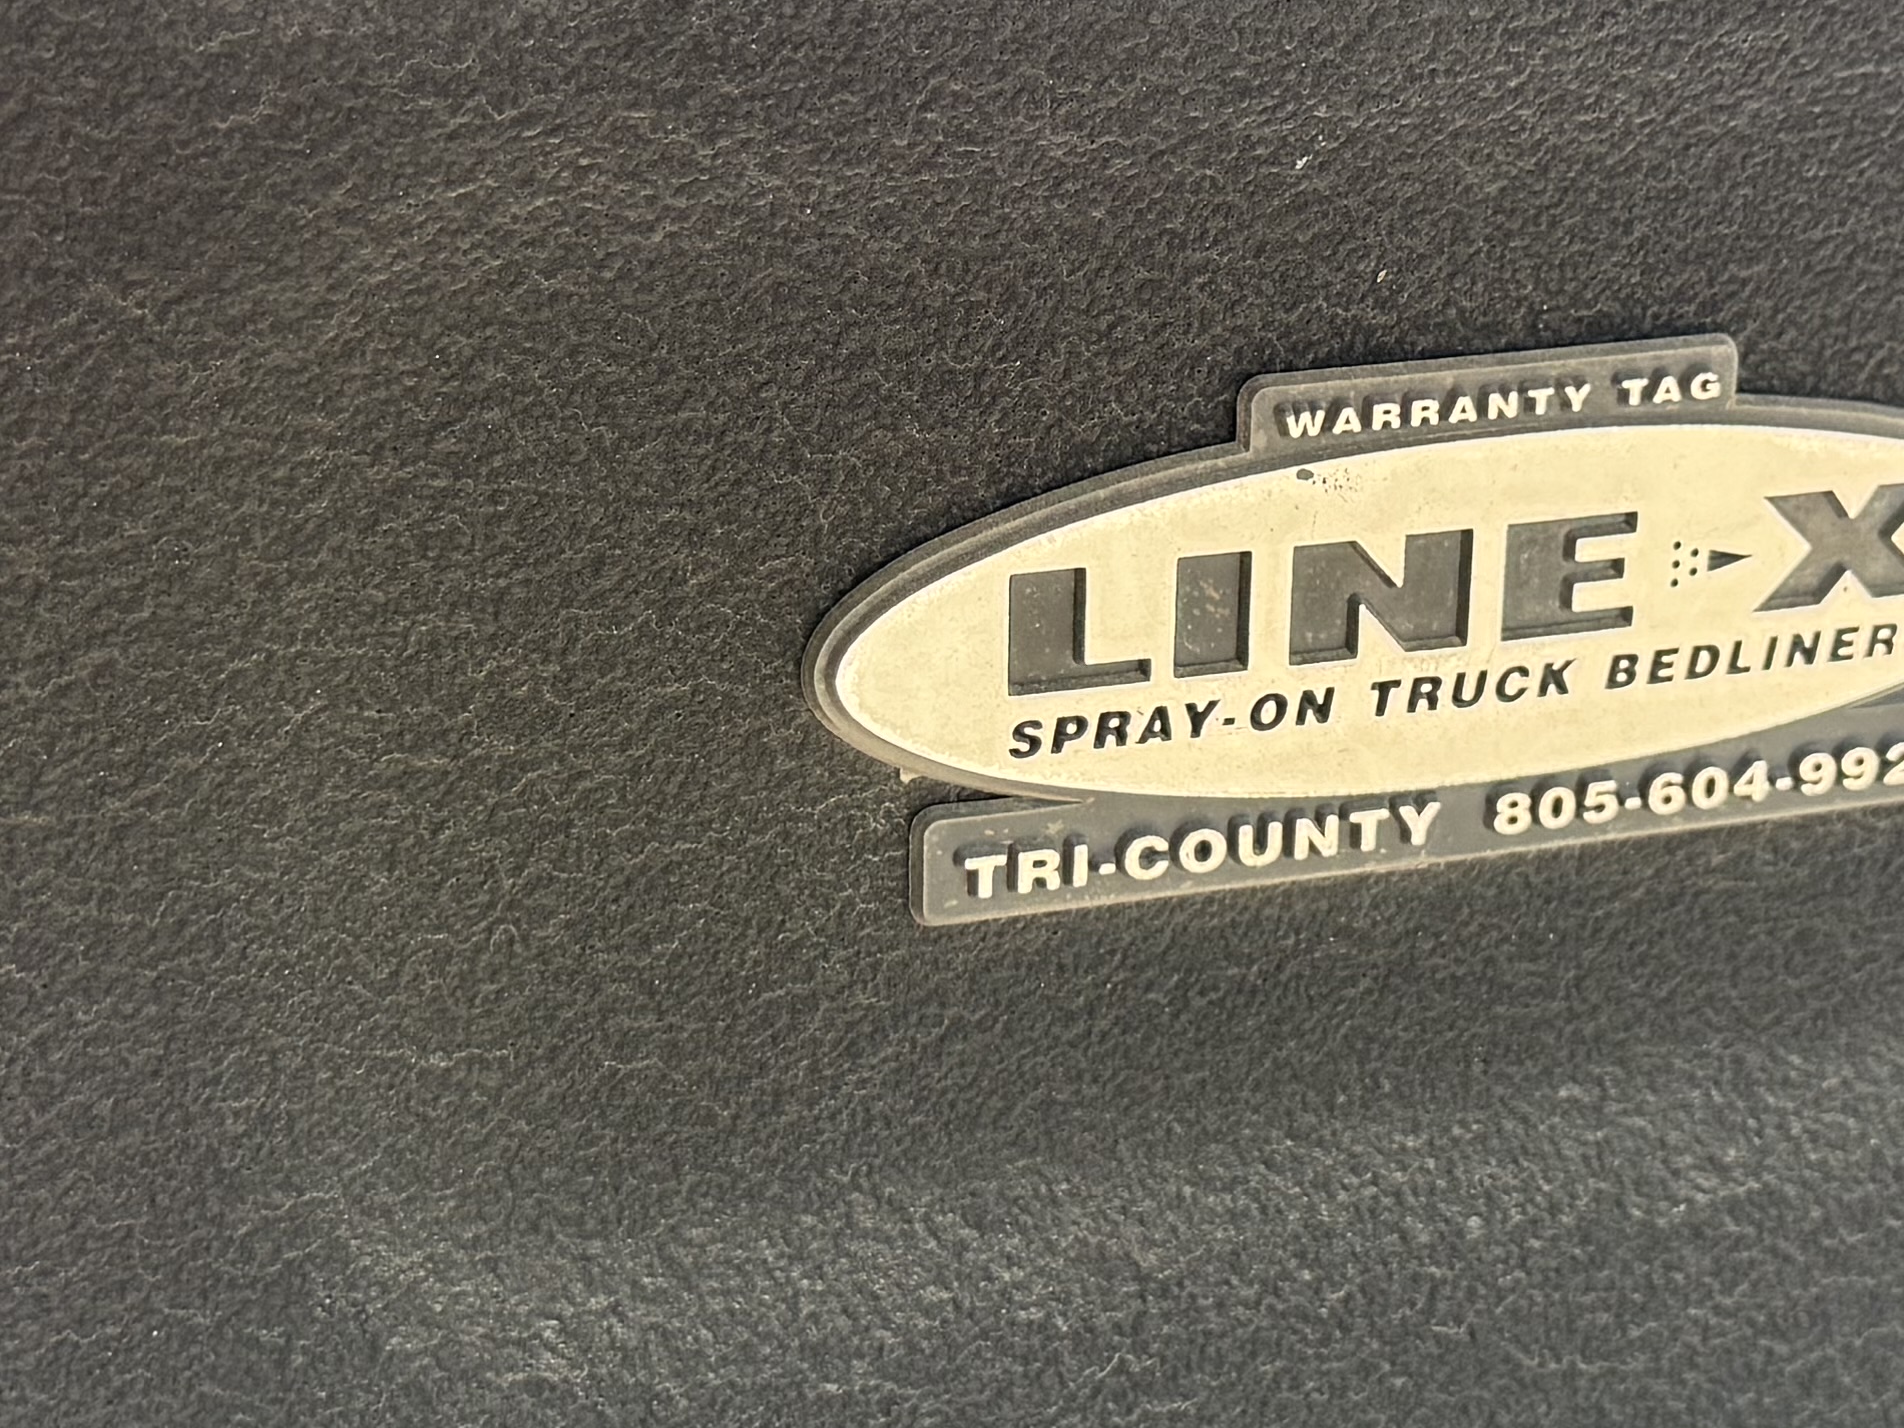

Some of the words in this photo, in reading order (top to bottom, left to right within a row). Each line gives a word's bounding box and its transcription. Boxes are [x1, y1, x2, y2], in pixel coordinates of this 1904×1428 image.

[1285, 383, 1593, 438] WARRANTY
[1622, 371, 1724, 404] TAG
[1008, 685, 1338, 758] SPRAY-ON
[1370, 660, 1575, 717] TRUCK
[964, 800, 1442, 898] TRI-COUNTY
